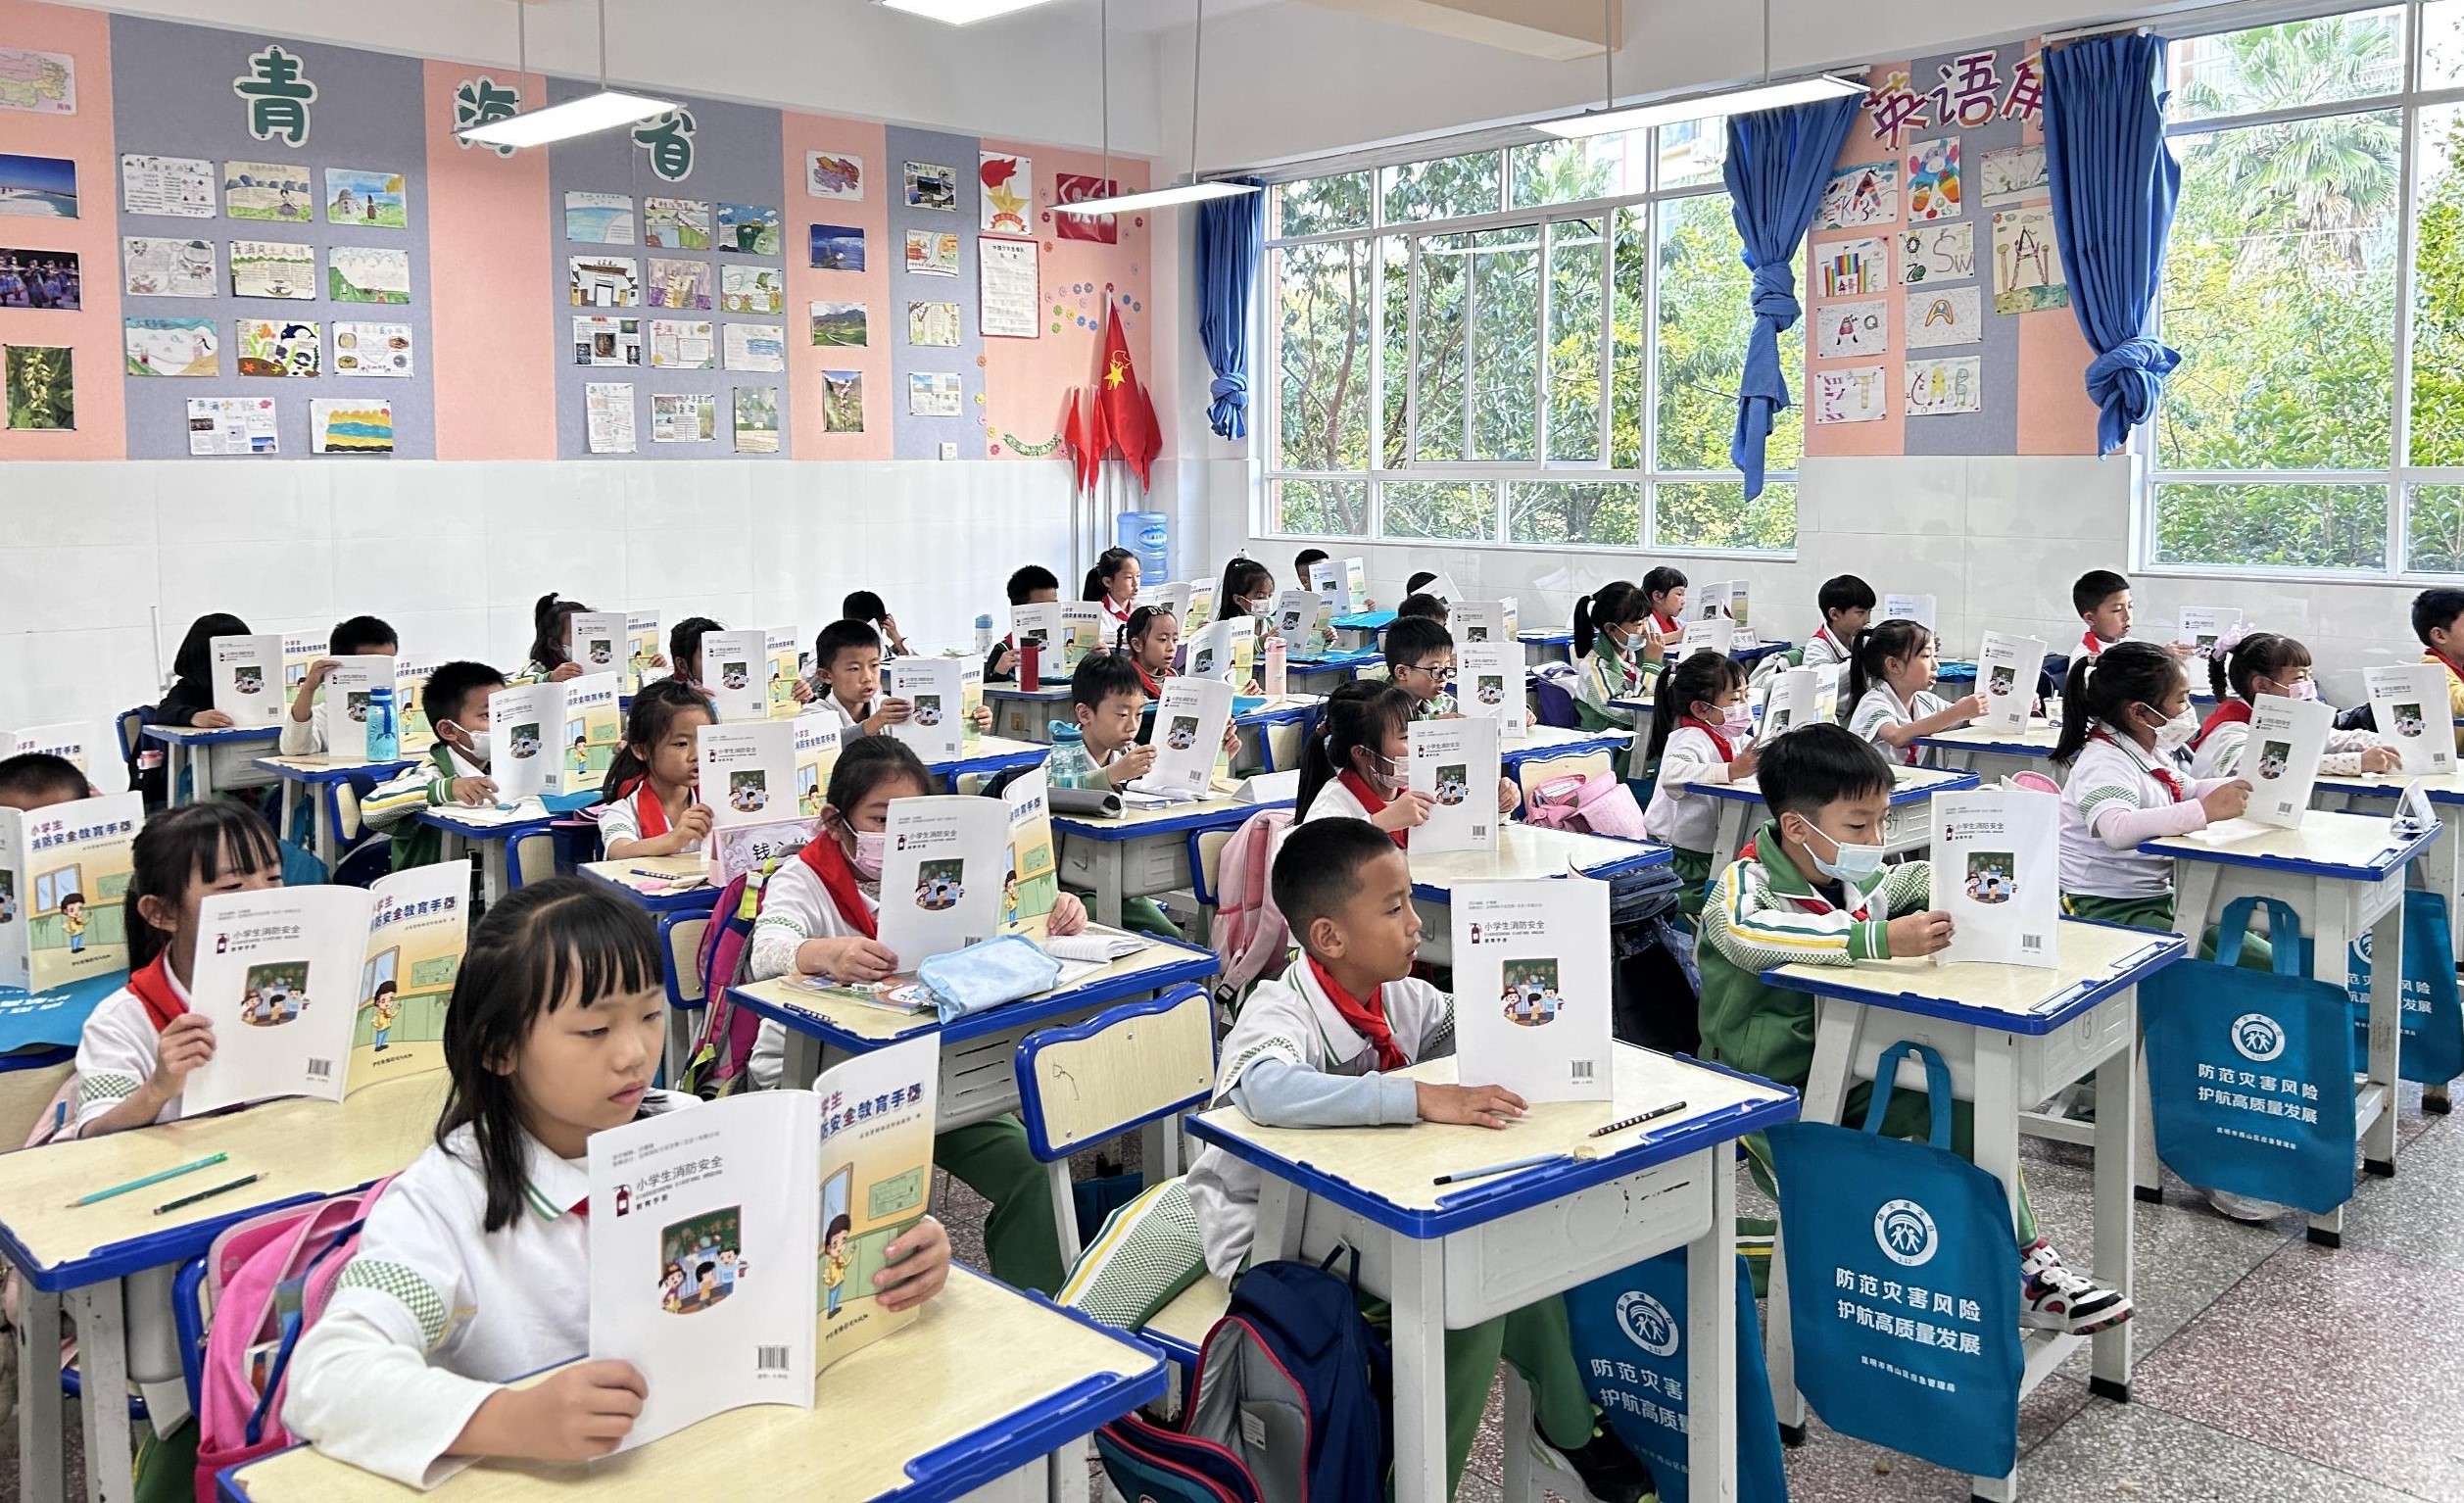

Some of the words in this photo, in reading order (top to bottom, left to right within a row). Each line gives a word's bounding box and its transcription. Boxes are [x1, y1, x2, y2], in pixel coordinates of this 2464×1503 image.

[238, 48, 314, 143] 青
[31, 820, 132, 850] 消防安全教育手册
[234, 924, 300, 939] 小学生消防安全
[1484, 920, 1545, 932] 小学生消防安全
[2198, 1063, 2319, 1101] 防范灾害风险
[2198, 1086, 2318, 1125] 护航高质量发展
[637, 1155, 723, 1191] 小学生消防安全
[1835, 1267, 1982, 1323] 防范灾害风险
[1836, 1299, 1981, 1356] 护航高质量发展
[1590, 1358, 1684, 1401] 防范灾害
